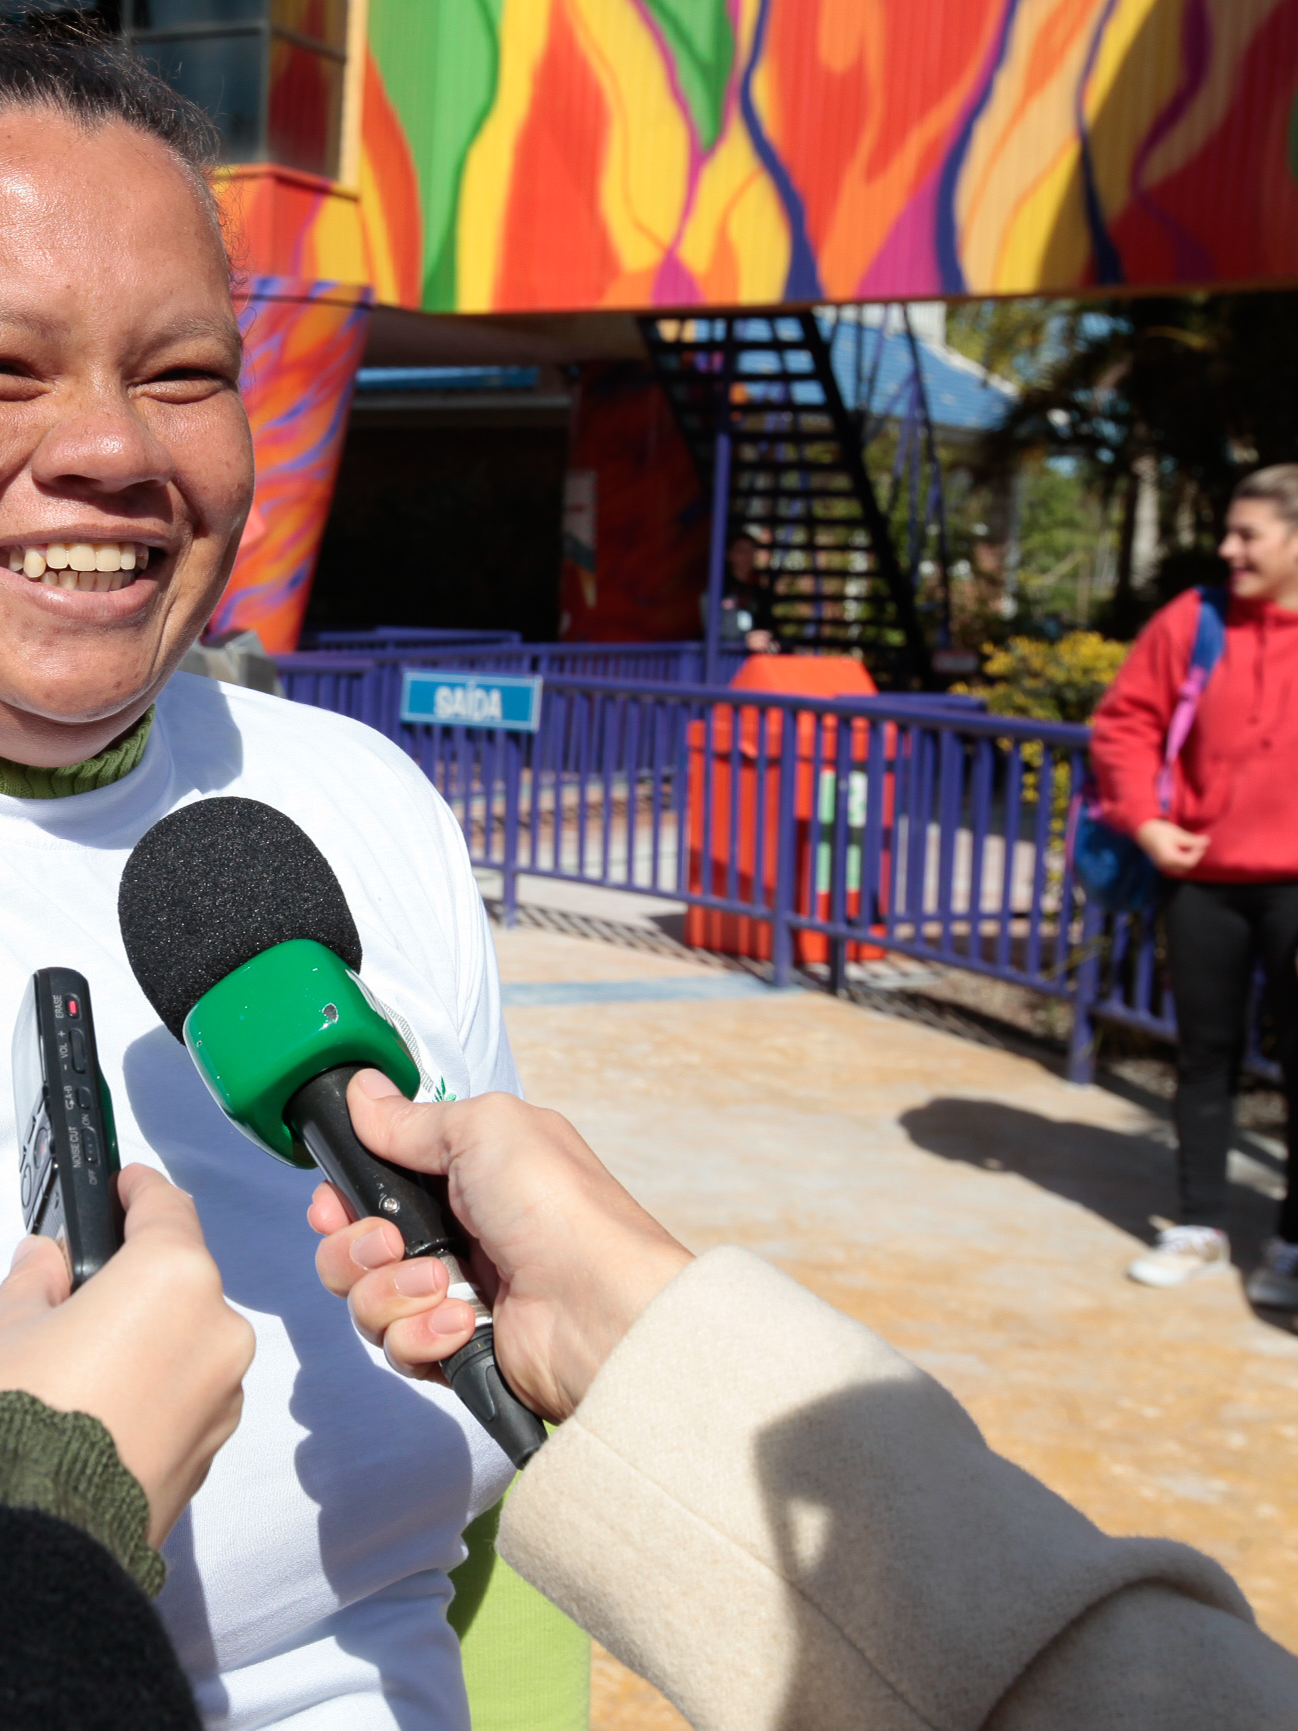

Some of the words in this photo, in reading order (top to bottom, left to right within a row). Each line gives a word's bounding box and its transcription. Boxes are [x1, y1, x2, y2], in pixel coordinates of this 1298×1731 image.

[433, 679, 502, 721] SAÍDA
[53, 994, 64, 1019] ERASE
[59, 1043, 68, 1058] VOL
[82, 1113, 90, 1126] ON
[68, 1126, 79, 1143] CUT
[70, 1143, 81, 1169] NOISE
[88, 1168, 97, 1185] OFF
